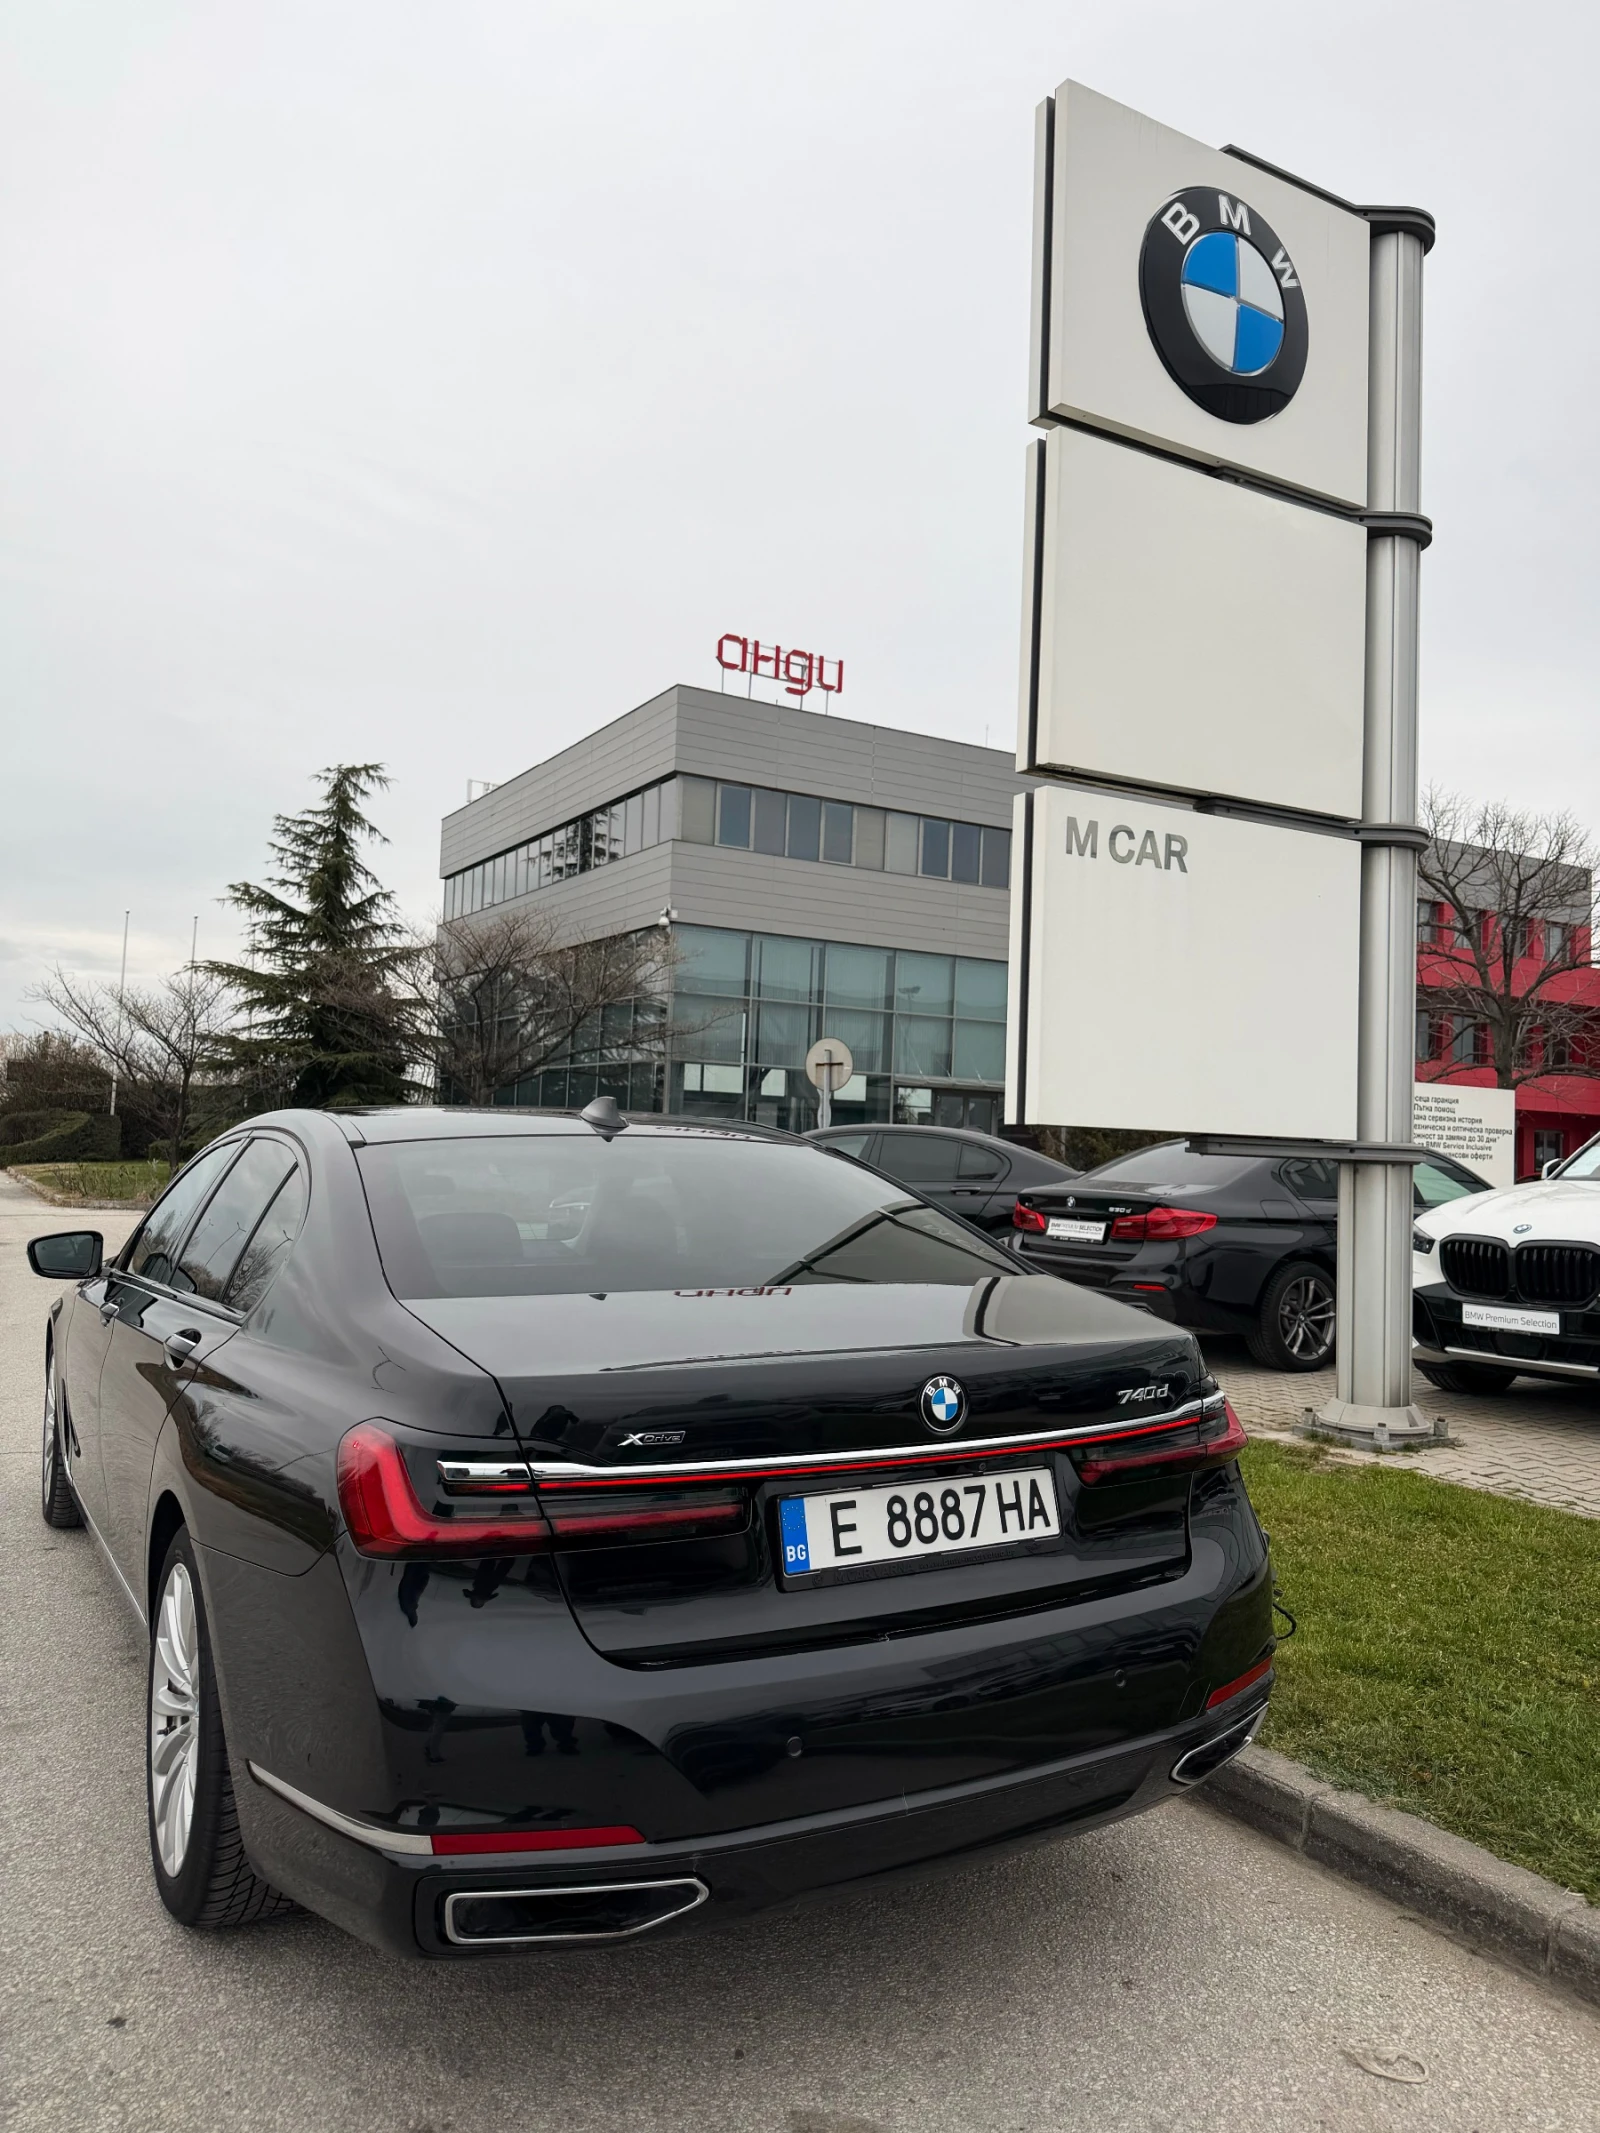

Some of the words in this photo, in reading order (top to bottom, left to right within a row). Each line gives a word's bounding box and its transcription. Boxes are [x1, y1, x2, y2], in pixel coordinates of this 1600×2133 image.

[1161, 194, 1300, 289] BMW
[1065, 815, 1099, 859] M
[1108, 824, 1188, 873] CAR
[1431, 1096, 1459, 1105] гаранция
[1434, 1106, 1456, 1114] помощ
[1458, 1117, 1483, 1125] история
[1484, 1127, 1513, 1136] проверка
[1425, 1141, 1441, 1149] BMW
[1443, 1141, 1465, 1150] Service
[1465, 1143, 1492, 1151] Inclusive
[1468, 1135, 1476, 1143] до
[1477, 1135, 1484, 1143] 30
[1470, 1152, 1493, 1161] оферти
[1464, 1310, 1484, 1321] BMW
[1485, 1314, 1519, 1325] Premium
[1520, 1317, 1558, 1329] Selection
[925, 1378, 961, 1396] BMW
[1116, 1383, 1169, 1405] 740d
[829, 1499, 863, 1557] E
[886, 1484, 986, 1548] 8887
[995, 1478, 1051, 1534] HA
[786, 1544, 807, 1562] BG
